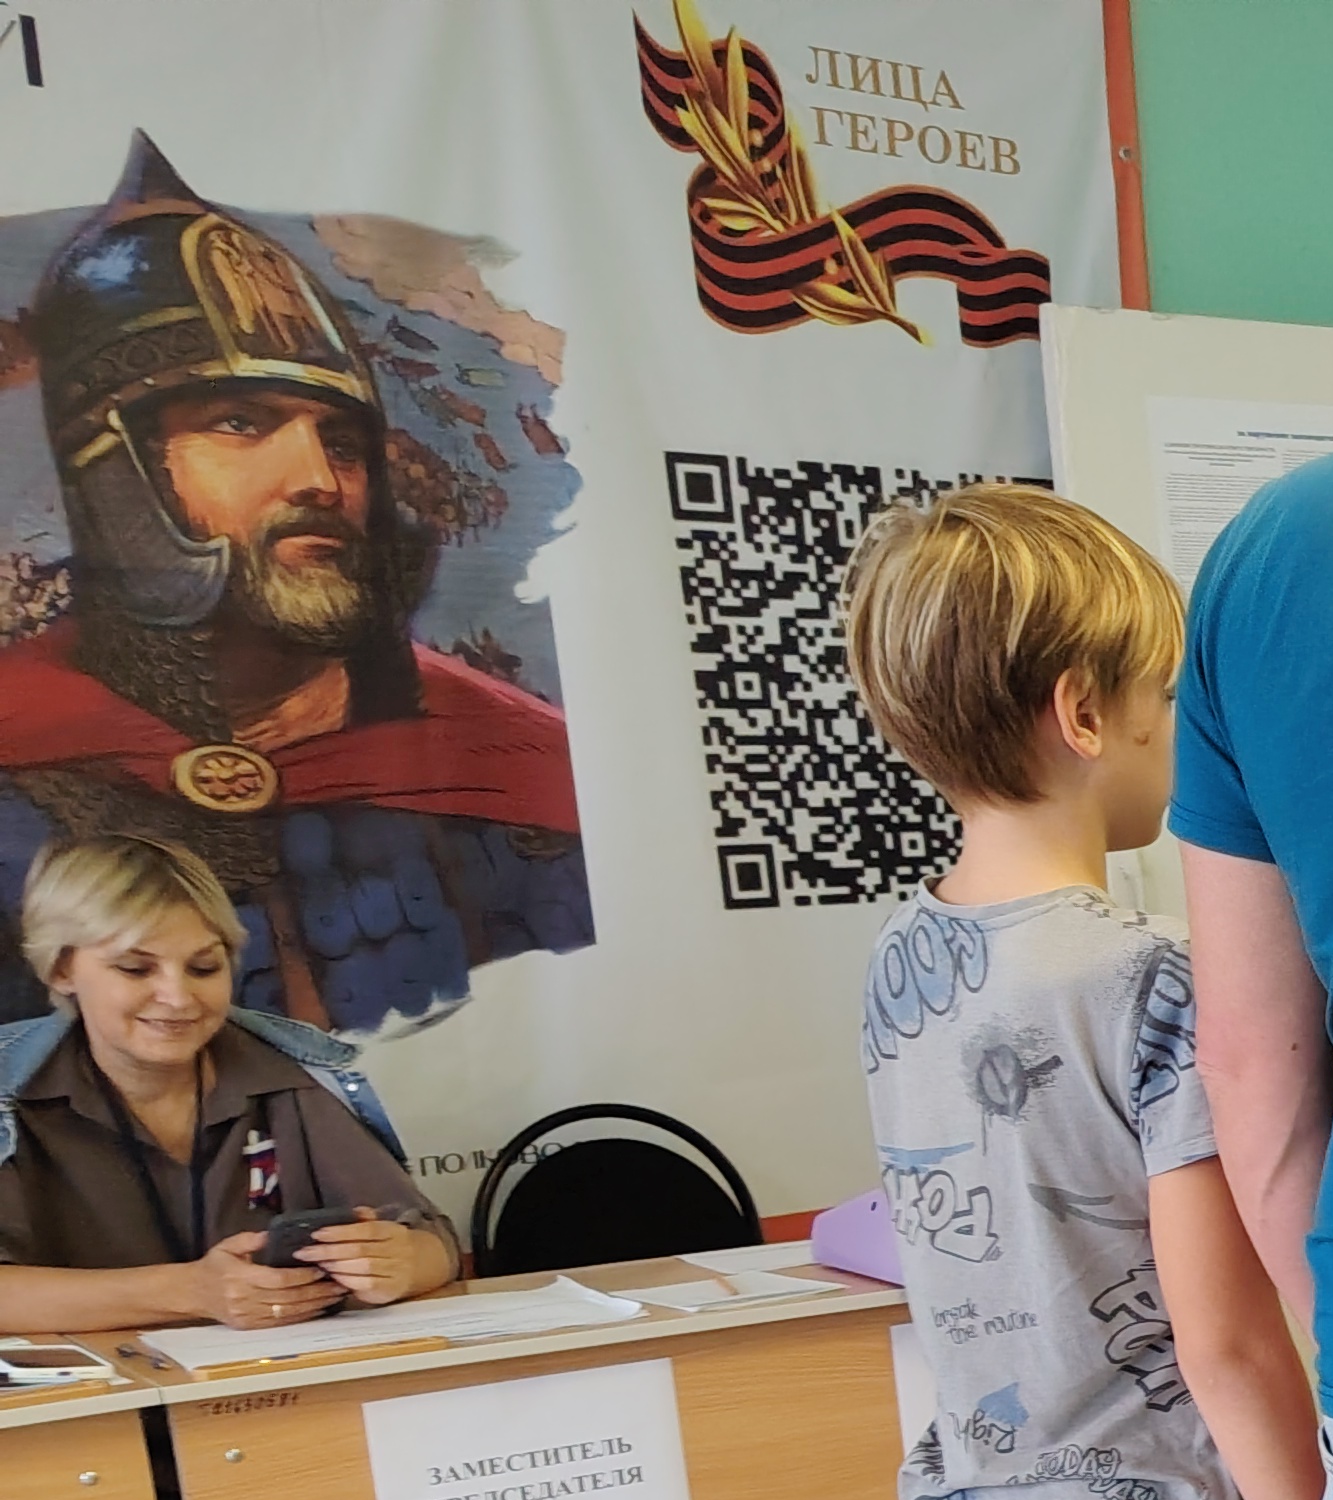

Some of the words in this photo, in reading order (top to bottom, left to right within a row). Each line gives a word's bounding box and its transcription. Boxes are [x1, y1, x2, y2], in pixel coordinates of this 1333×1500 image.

[805, 45, 966, 112] ЛИЦА
[810, 106, 1021, 176] ГЕРОЕВ
[426, 1435, 633, 1487] ЗАМЕСТИТЕЛЬ
